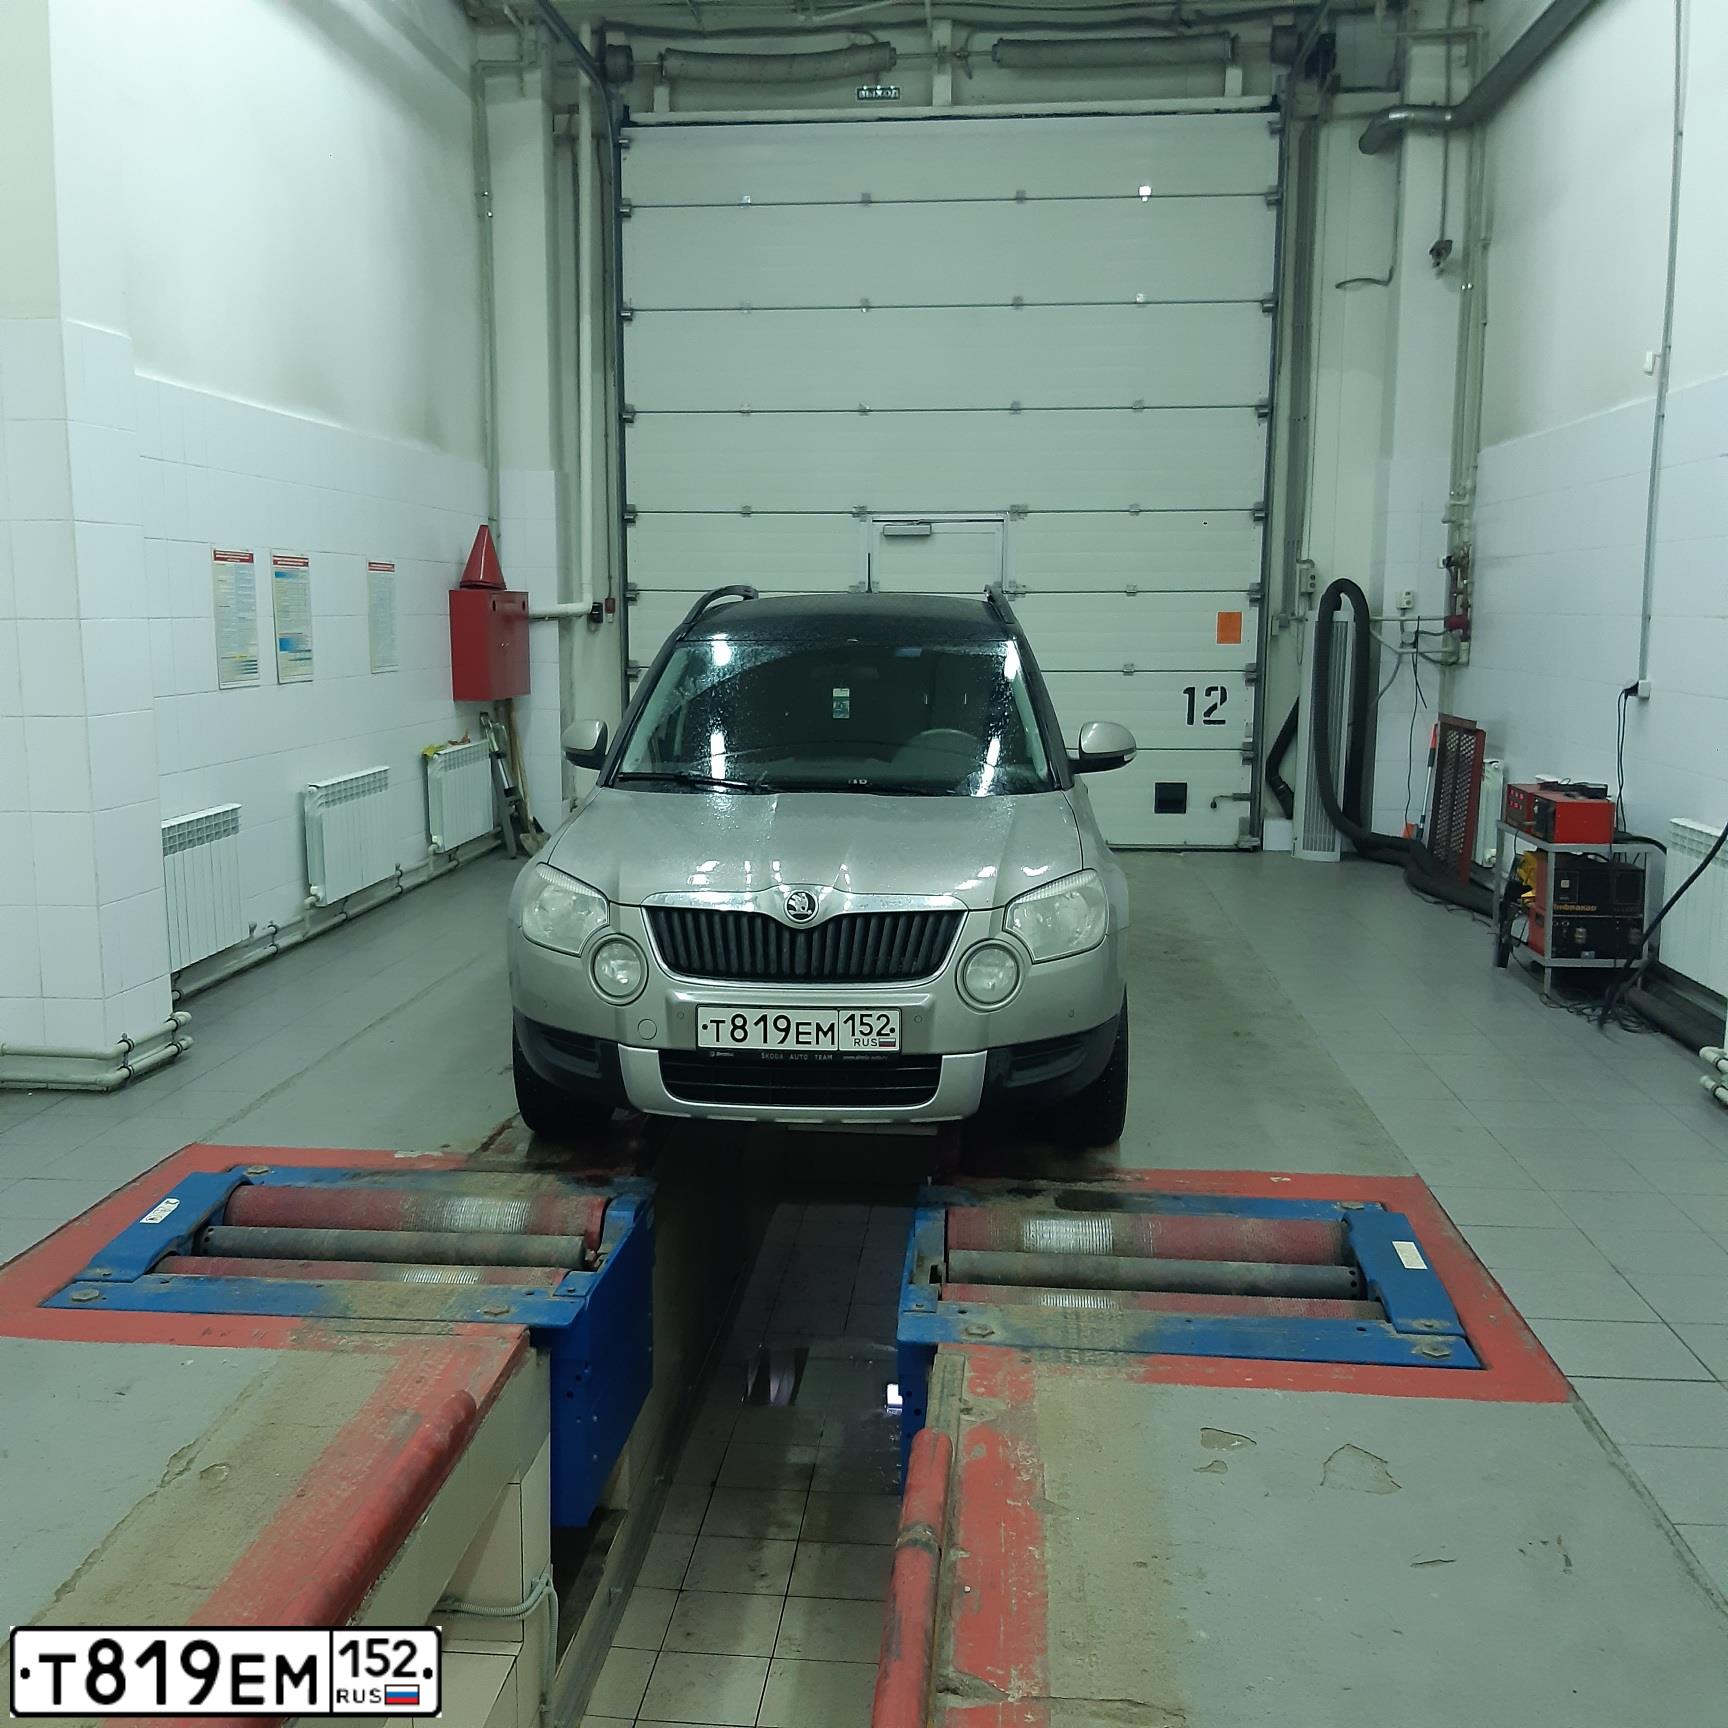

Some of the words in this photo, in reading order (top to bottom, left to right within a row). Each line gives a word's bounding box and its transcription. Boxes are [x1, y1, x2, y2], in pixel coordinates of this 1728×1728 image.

[1183, 686, 1228, 725] 12
[843, 1013, 891, 1037] 152
[853, 1038, 878, 1047] RUS
